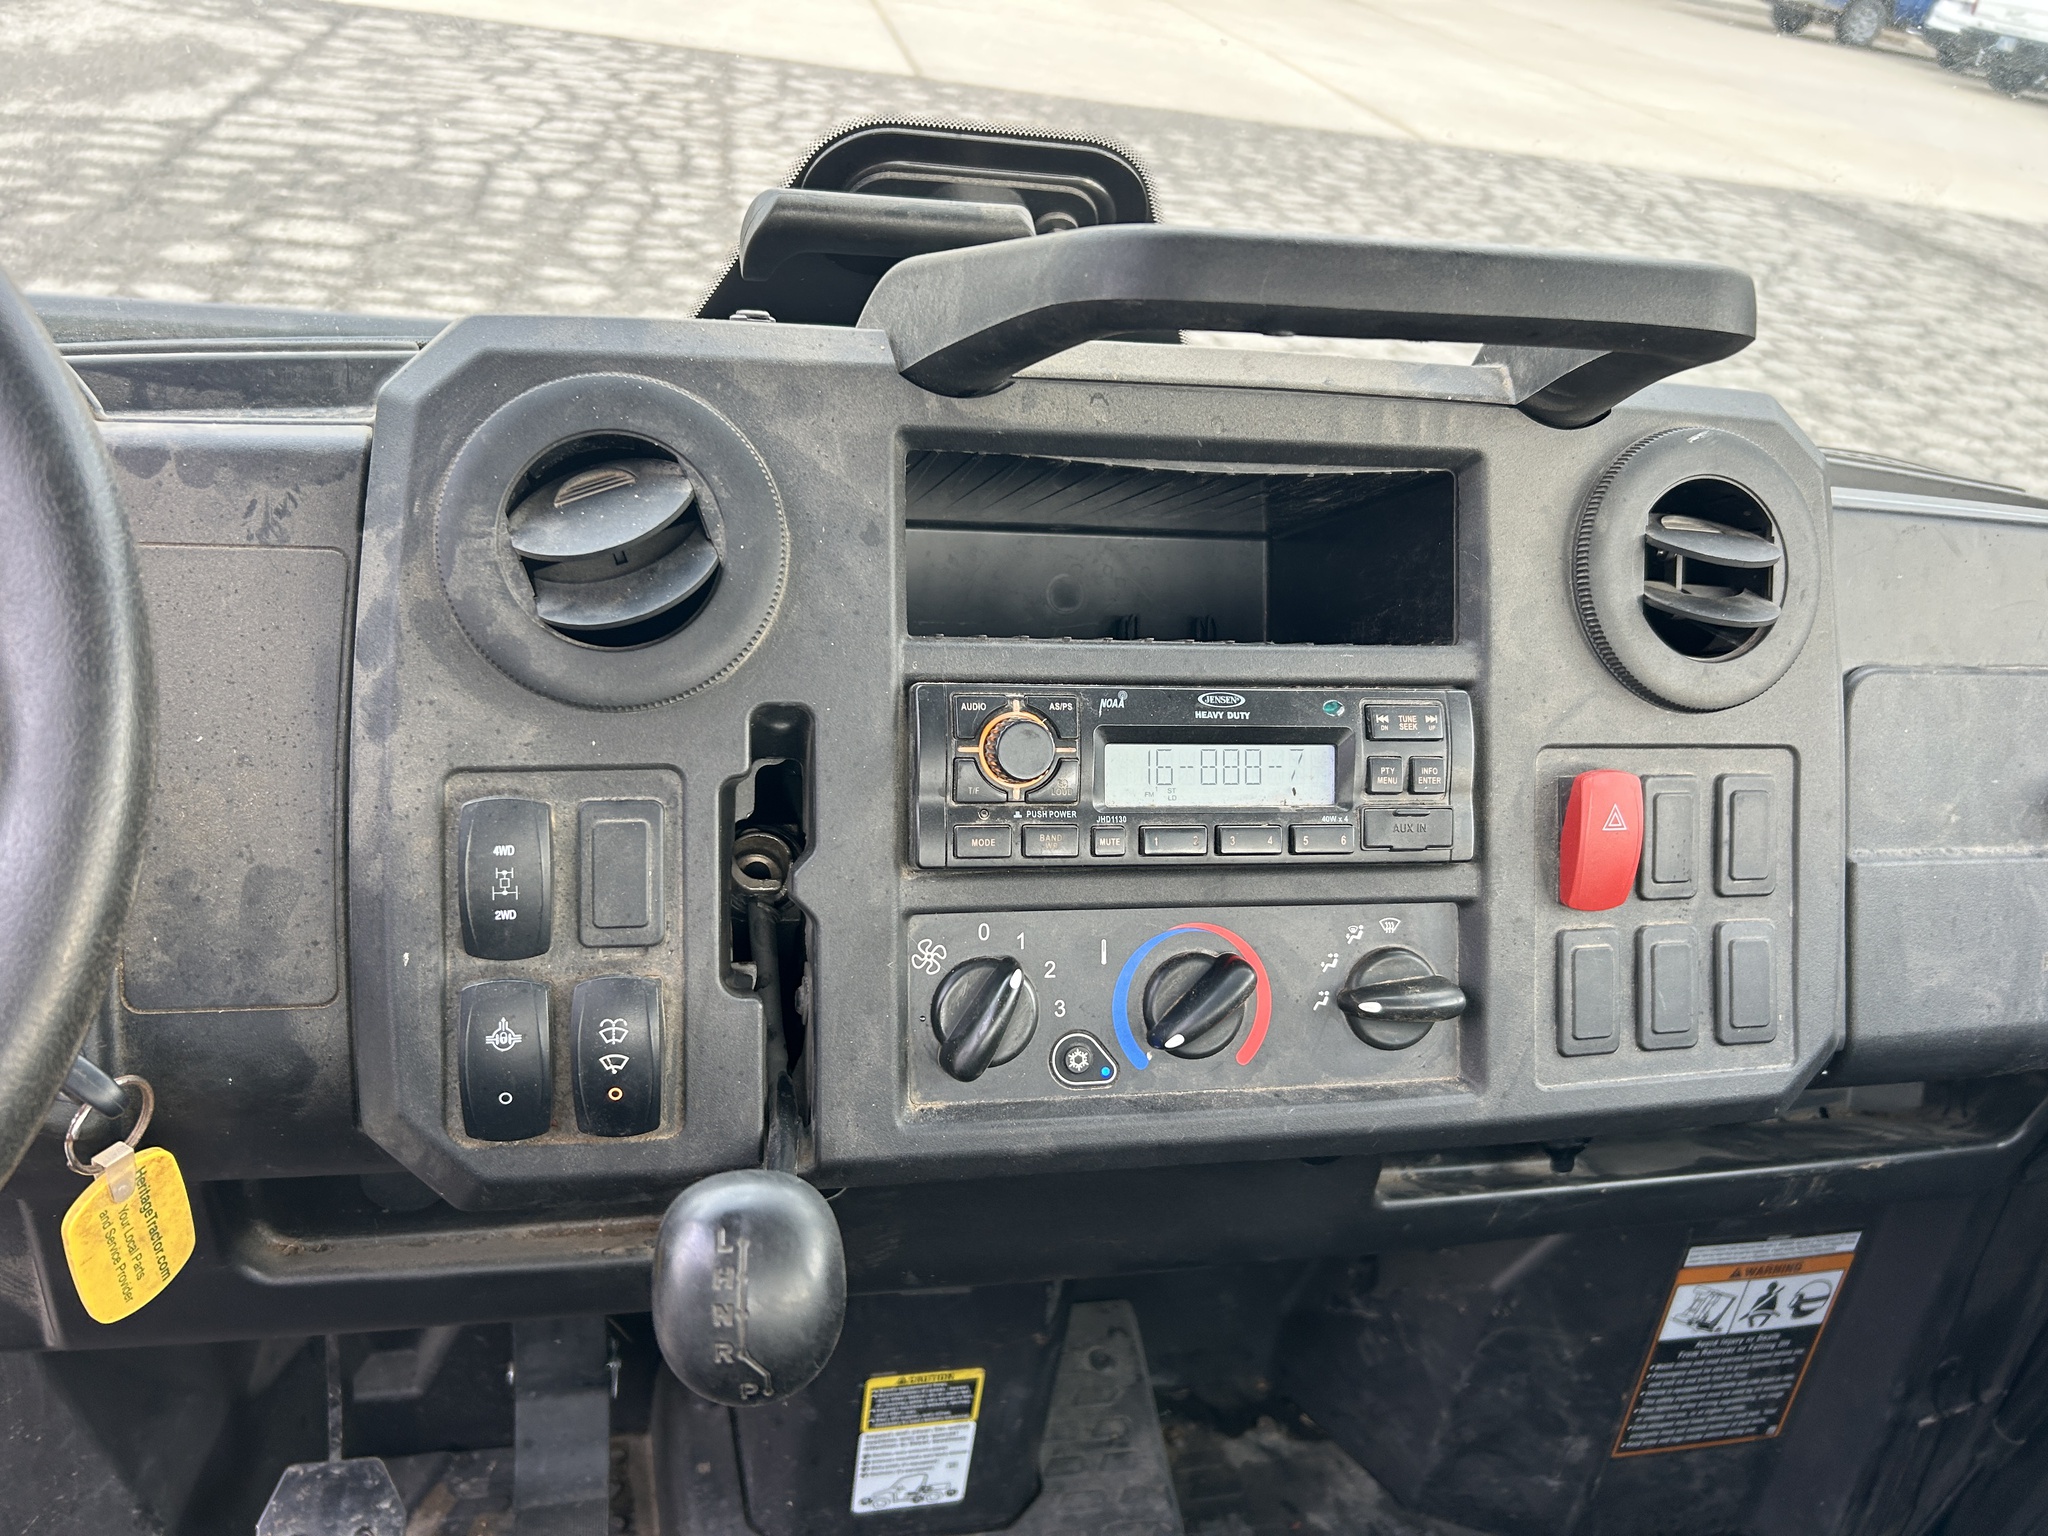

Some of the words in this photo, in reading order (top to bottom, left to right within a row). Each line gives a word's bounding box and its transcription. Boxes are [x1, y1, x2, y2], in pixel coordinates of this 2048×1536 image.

[1204, 695, 1237, 704] JENSEN
[961, 702, 987, 711] AUDIO
[1049, 702, 1073, 711] AS/PS
[1098, 698, 1125, 718] NOAA
[1194, 710, 1224, 719] HEAVY
[1226, 711, 1250, 720] DUTY
[1398, 715, 1417, 723] TUNE
[1399, 723, 1418, 731] SEEK
[1380, 767, 1395, 775] PTY
[1421, 767, 1438, 775] INFO
[1377, 776, 1398, 785] MENU
[1418, 776, 1442, 785] ENTER
[968, 786, 980, 795] T/F
[1051, 787, 1074, 796] LOUD
[1026, 810, 1048, 818] PUSH
[1049, 810, 1077, 818] POWER
[1096, 815, 1127, 823] JHD1130
[1321, 815, 1337, 823] 40W
[1393, 823, 1414, 833] AUX
[1416, 823, 1427, 833] IN
[971, 838, 996, 847] MODE
[1039, 833, 1063, 842] BAND
[1099, 837, 1121, 846] MUTE
[1192, 835, 1199, 846] 2
[1229, 835, 1236, 846] 3
[1267, 835, 1273, 846] 4
[1303, 835, 1309, 846] 5
[1340, 835, 1347, 846] 6
[493, 845, 515, 856] 4WD
[494, 910, 517, 920] 2WD
[978, 923, 990, 941] 0
[1016, 931, 1025, 950] 1
[1044, 960, 1056, 978] 2
[1054, 999, 1066, 1018] 3
[99, 1209, 114, 1230] and
[118, 1203, 130, 1230] Your
[135, 1165, 171, 1282] HeritageTractor.com
[124, 1226, 140, 1256] Local
[717, 1227, 734, 1253] L
[105, 1227, 121, 1266] Service
[131, 1252, 145, 1281] Parts
[1745, 1262, 1804, 1277] WARNING
[115, 1262, 134, 1303] Provider
[712, 1266, 735, 1291] H
[712, 1302, 735, 1328] N
[714, 1341, 735, 1364] R
[739, 1383, 758, 1400] P
